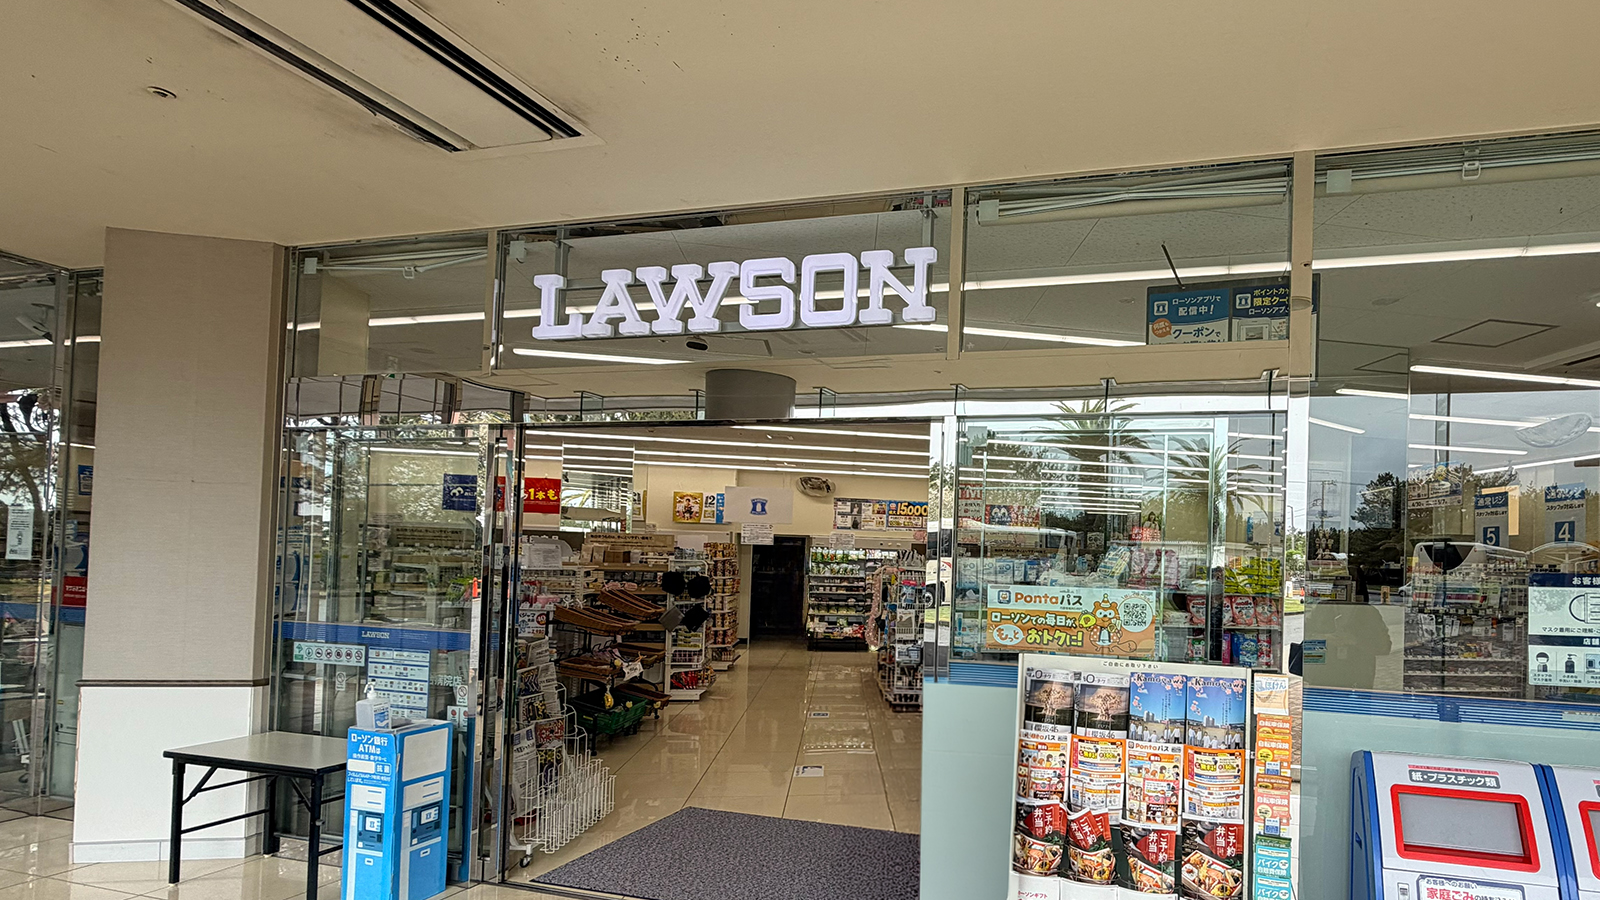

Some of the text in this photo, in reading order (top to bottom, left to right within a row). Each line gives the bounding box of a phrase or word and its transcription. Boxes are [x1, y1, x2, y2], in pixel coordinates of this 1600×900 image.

[532, 247, 938, 340] LAWSON
[1172, 296, 1221, 305] ローソンアプリで
[1172, 327, 1221, 339] クーポンで
[1486, 527, 1496, 546] 5
[1558, 523, 1571, 543] 4
[991, 611, 1078, 628] ローソンでの毎日が、
[996, 628, 1021, 642] もっと
[1136, 674, 1185, 686] Kamogawa
[1194, 678, 1245, 690] Kamogawa
[351, 733, 388, 746] ローソン銀行
[358, 744, 381, 754] ATMは
[1411, 771, 1498, 788] 紙・プラスチック類
[1033, 807, 1044, 828] 弁当
[1045, 806, 1053, 834] ご予約
[1148, 832, 1158, 853] 弁当
[1216, 826, 1226, 847] 弁当
[1227, 826, 1237, 857] ご予約
[1159, 832, 1169, 863] ご予約
[1257, 859, 1278, 869] バイク
[1426, 878, 1478, 889] お客様へのお願い
[1257, 888, 1279, 898] バイク
